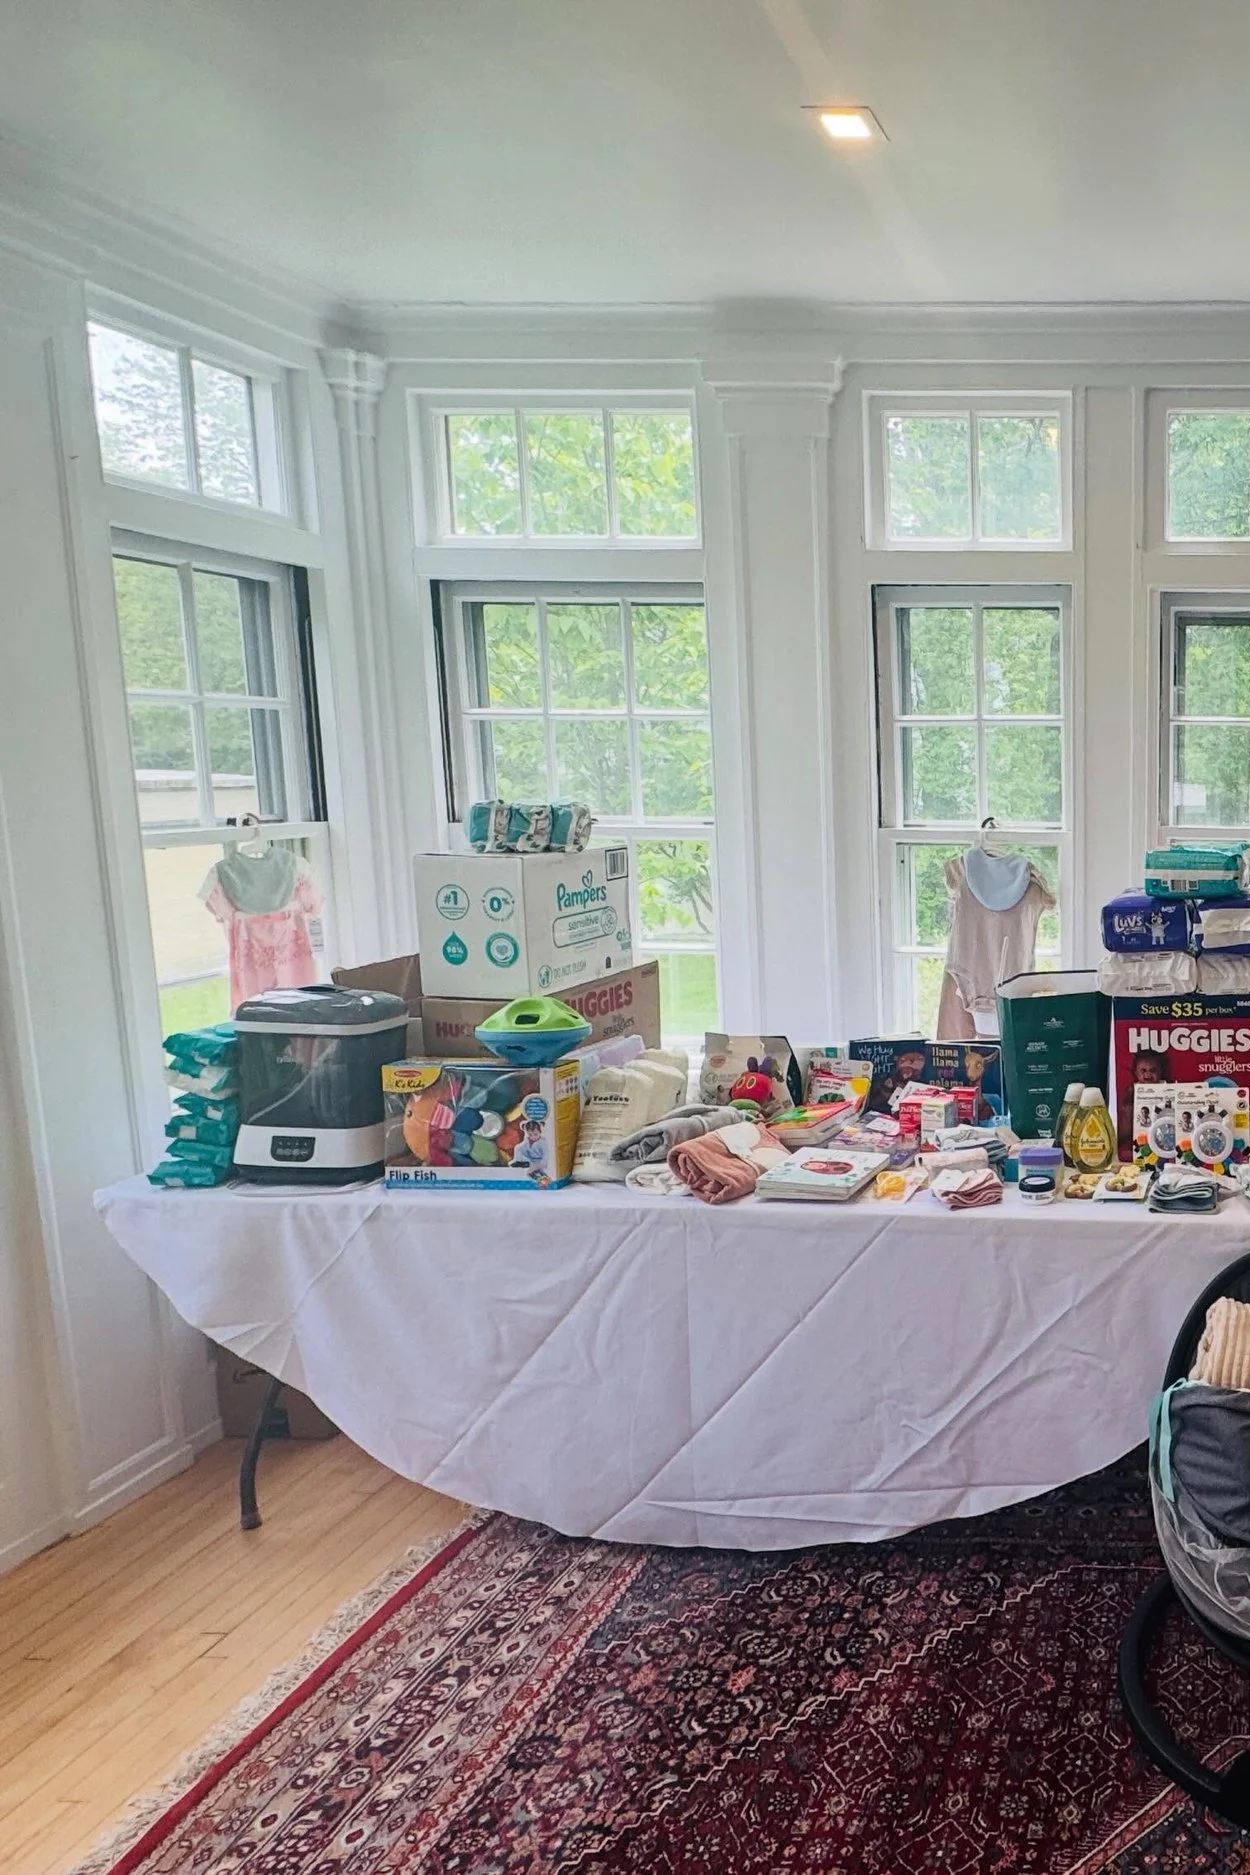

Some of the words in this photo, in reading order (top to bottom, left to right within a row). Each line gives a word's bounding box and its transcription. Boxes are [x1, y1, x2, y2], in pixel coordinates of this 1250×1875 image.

[557, 882, 607, 912] Pampers
[1140, 1003, 1169, 1015] Save
[1171, 1001, 1203, 1018] $35
[1205, 1008, 1218, 1016] per
[932, 1046, 959, 1057] llama
[932, 1057, 959, 1068] llama
[389, 1170, 410, 1183] Flip
[414, 1170, 437, 1181] Fish
